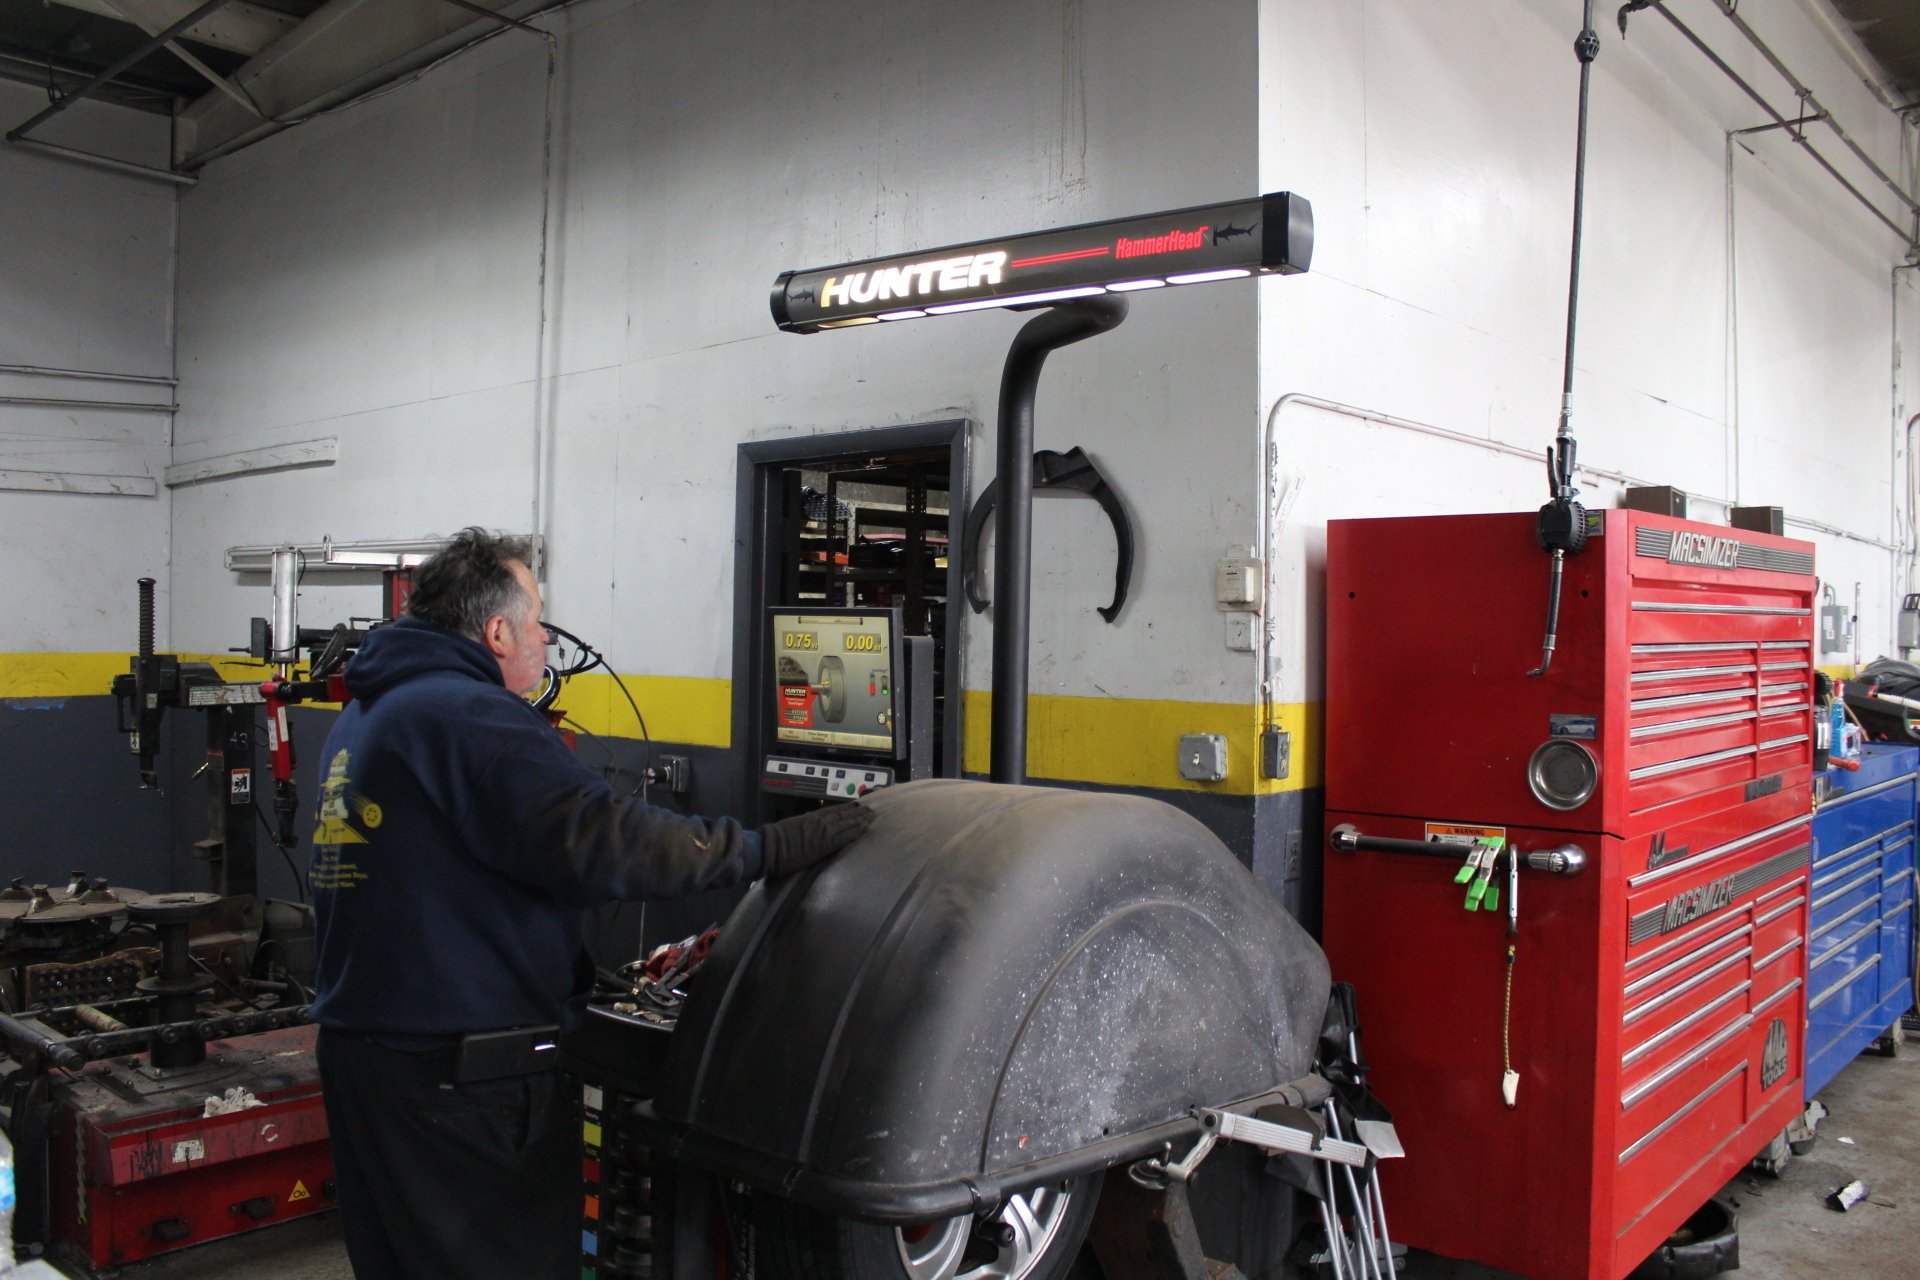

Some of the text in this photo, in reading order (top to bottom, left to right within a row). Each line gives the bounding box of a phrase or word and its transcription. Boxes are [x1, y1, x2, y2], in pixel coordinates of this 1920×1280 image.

[821, 226, 1209, 307] HUNTER HammerHead
[1669, 530, 1741, 568] MACSIMIZER
[786, 633, 811, 648] 0.75
[846, 635, 874, 650] 0.00
[1454, 827, 1485, 837] WARNING
[1662, 873, 1736, 933] MACSIMIZER
